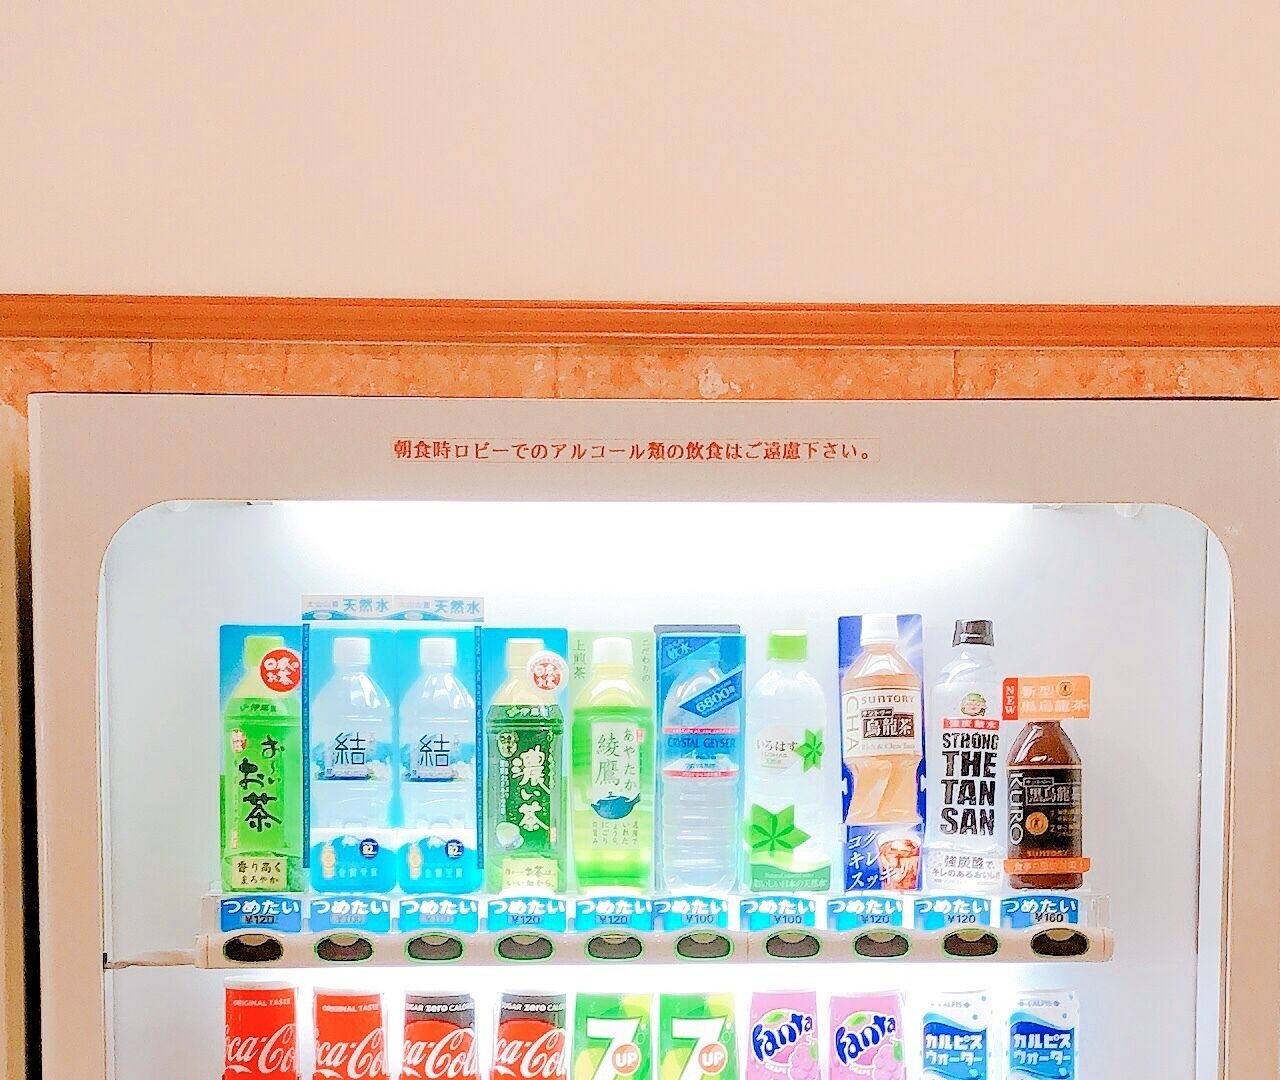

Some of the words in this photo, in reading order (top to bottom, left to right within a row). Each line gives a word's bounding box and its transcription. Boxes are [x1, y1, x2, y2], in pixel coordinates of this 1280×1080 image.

[394, 439, 872, 461] 朝食時ロビーでのアルコール類の飲食はご遠慮下さい。
[343, 599, 389, 612] 天然水
[435, 599, 480, 613] 天然水
[862, 695, 914, 704] SUNTORY
[1005, 685, 1016, 715] NEW
[865, 718, 913, 737] 烏龍茶
[335, 732, 366, 765] 結
[419, 733, 450, 767] 結
[667, 738, 699, 748] CRYSTAL
[704, 738, 736, 748] GEYSER
[942, 733, 999, 750] STRONG
[595, 733, 621, 786] 綾鷹
[623, 728, 637, 793] あやたか
[942, 751, 997, 778] THE
[511, 745, 551, 831] 濃い茶
[941, 780, 996, 806] TAN
[1009, 769, 1024, 846] KURO
[940, 808, 995, 835] SAN
[222, 900, 300, 915] つめたい
[311, 900, 388, 915] つめたい
[915, 899, 989, 914] つめたい
[1002, 898, 1078, 913] つめたい
[245, 914, 274, 925] ¥120
[510, 914, 540, 925] ¥120
[597, 914, 627, 925] ¥120
[948, 914, 976, 924] ¥120
[752, 1013, 813, 1062] Fanta
[835, 1015, 896, 1065] Fanta
[926, 1032, 983, 1051] カルピス
[1013, 1033, 1071, 1050] カルピス
[614, 1052, 638, 1067] UP
[701, 1052, 725, 1066] UP
[926, 1050, 983, 1066] ウォーター
[1013, 1050, 1071, 1066] ウォーター
